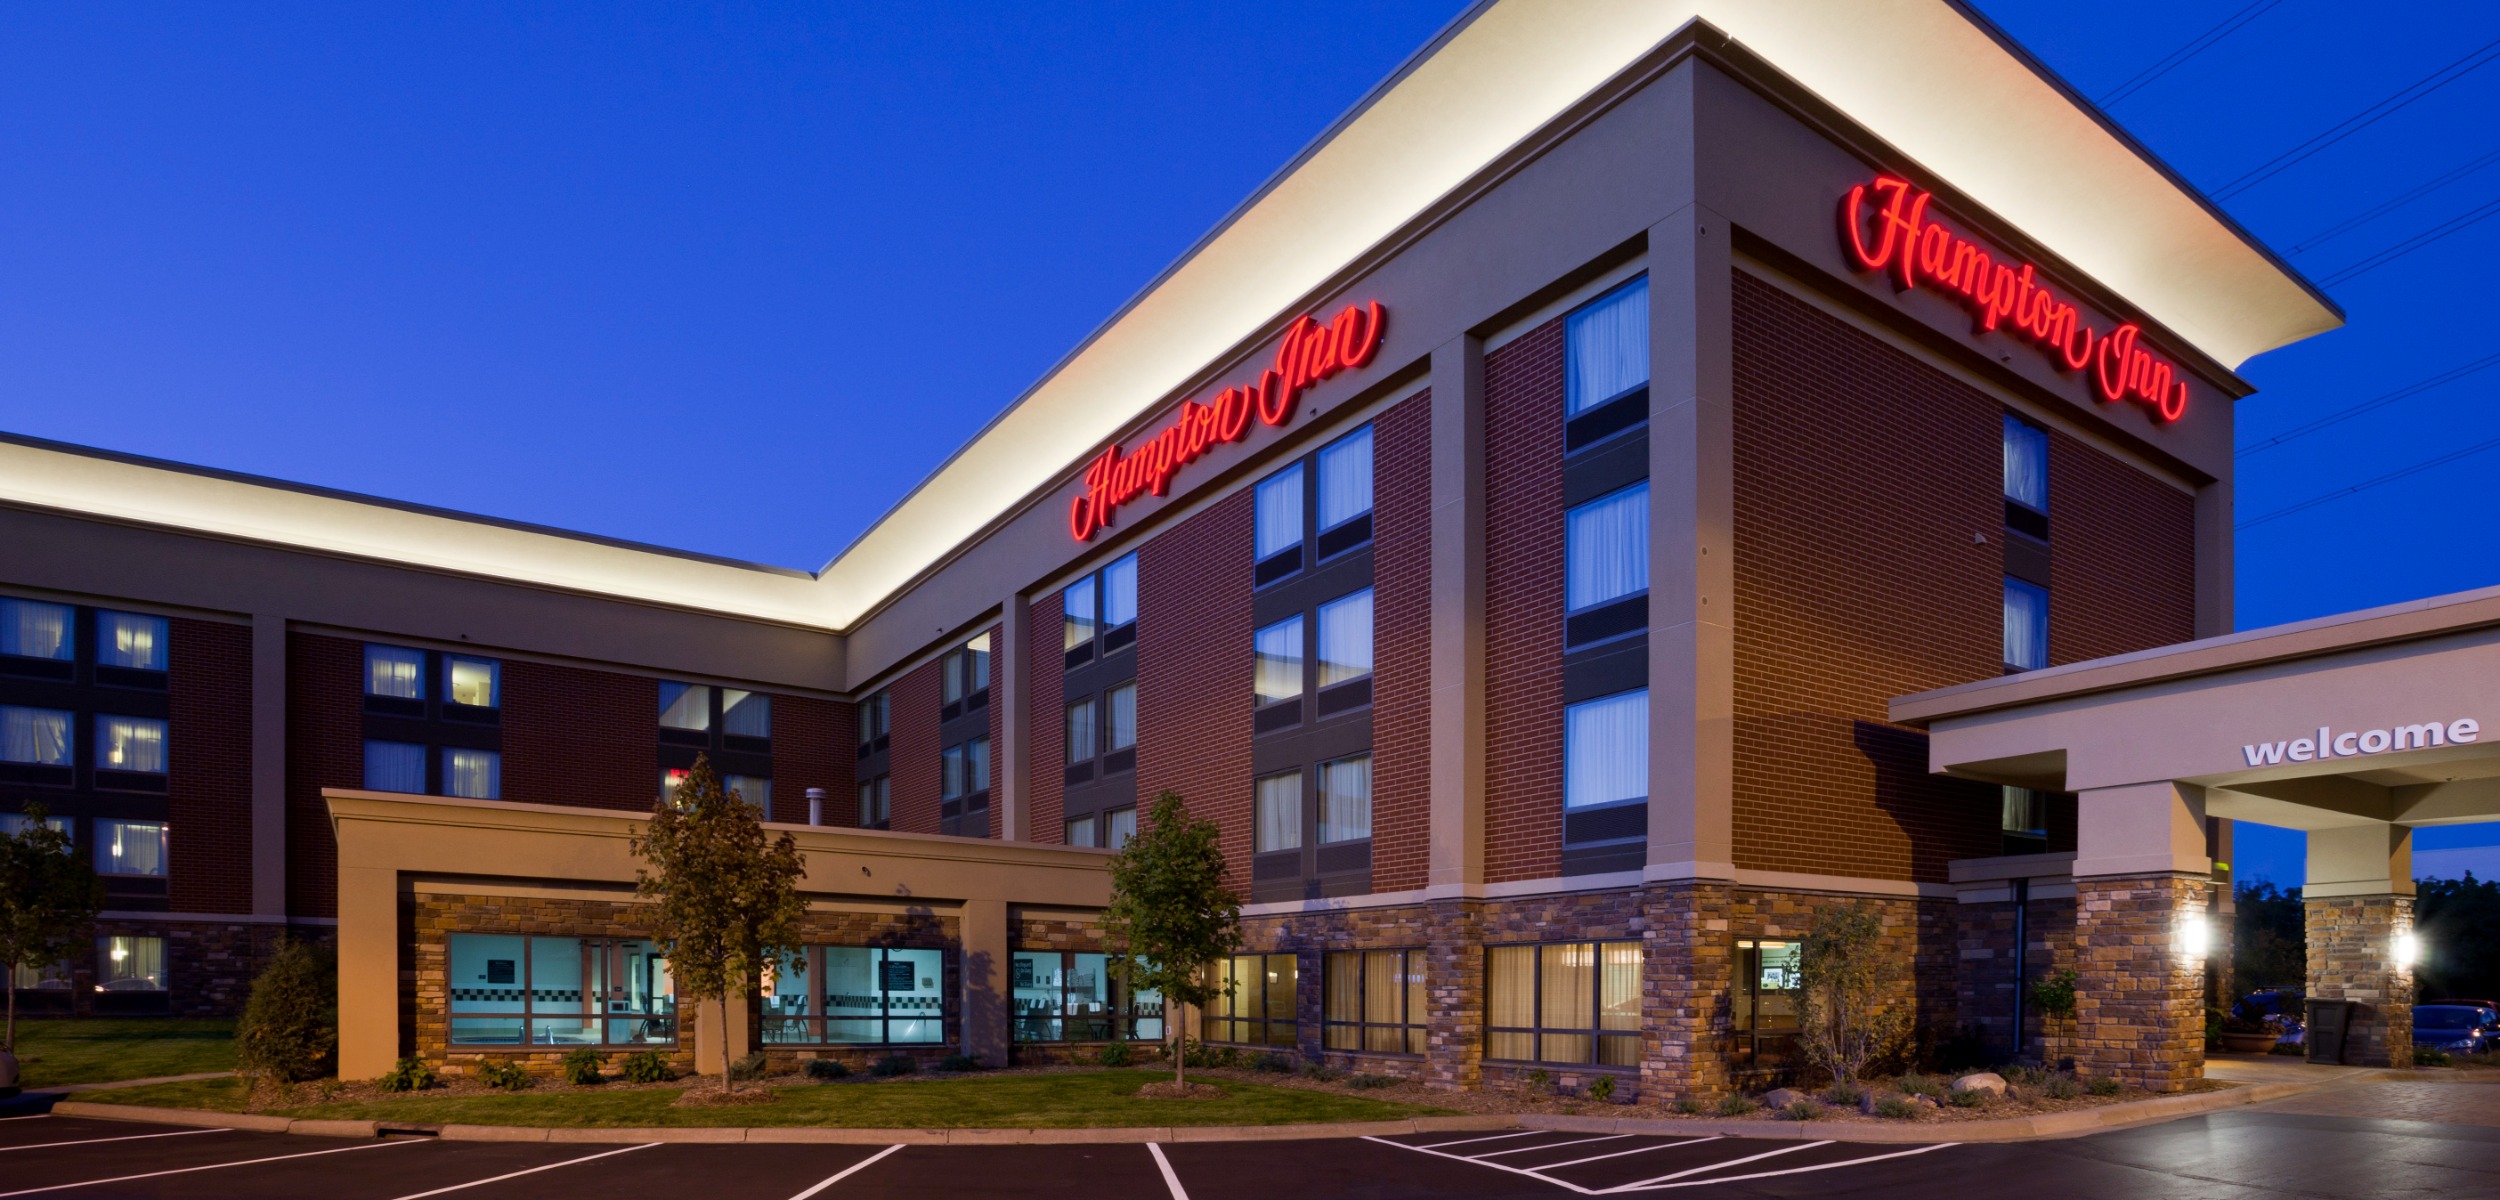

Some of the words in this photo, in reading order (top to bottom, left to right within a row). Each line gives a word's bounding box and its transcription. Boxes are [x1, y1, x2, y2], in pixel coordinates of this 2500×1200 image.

[1846, 175, 2092, 368] Hampton
[2100, 324, 2186, 420] Inn
[1071, 384, 1256, 541] Hampton
[1258, 300, 1384, 424] Inn
[2243, 718, 2480, 766] welcome
